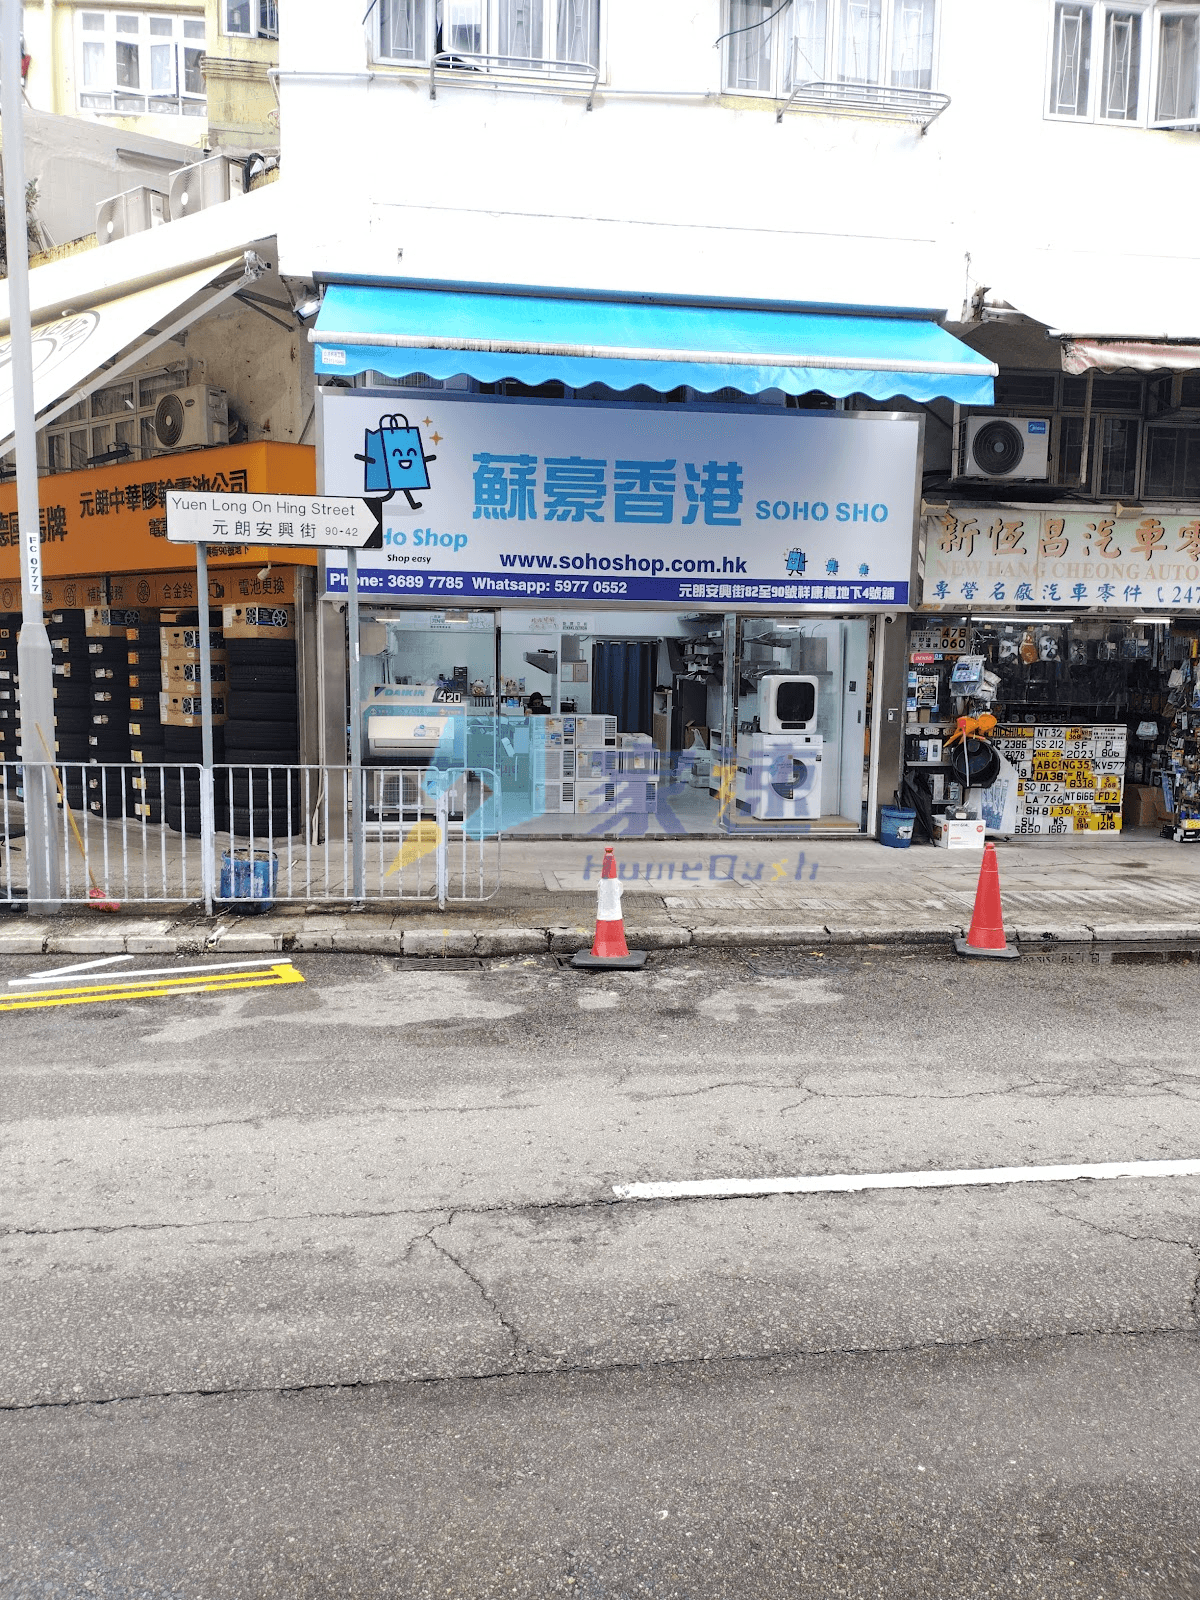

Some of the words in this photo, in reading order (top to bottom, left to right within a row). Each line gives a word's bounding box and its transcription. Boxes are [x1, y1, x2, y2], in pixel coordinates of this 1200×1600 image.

[472, 452, 744, 527] 蘇豪香港
[171, 496, 208, 511] Yuen
[212, 498, 247, 515] Long
[252, 500, 272, 513] On
[276, 501, 306, 517] Hing
[311, 502, 356, 518] Street
[755, 499, 829, 522] SOHO
[835, 501, 889, 523] SHO
[212, 519, 317, 539] 元朗安興街
[324, 526, 359, 538] 90-42
[29, 536, 38, 553] FC
[412, 527, 469, 553] Shop
[387, 553, 410, 564] Shop
[411, 556, 432, 565] easy
[499, 552, 748, 577] www.sohoshop.com.hk
[30, 557, 39, 592] 0777
[936, 559, 984, 577] NEW
[986, 562, 1046, 579] HANG
[1051, 563, 1140, 580] CHEONG
[1145, 564, 1200, 581] AUTO
[238, 577, 285, 597] 電池更換
[387, 575, 424, 590] 3689
[428, 576, 464, 591] 7785
[472, 577, 551, 595] Whatsapp:
[554, 579, 589, 594] 5977
[592, 580, 628, 595] 0552
[437, 690, 461, 703] 420
[1037, 729, 1049, 738] NT
[1049, 740, 1064, 749] 212
